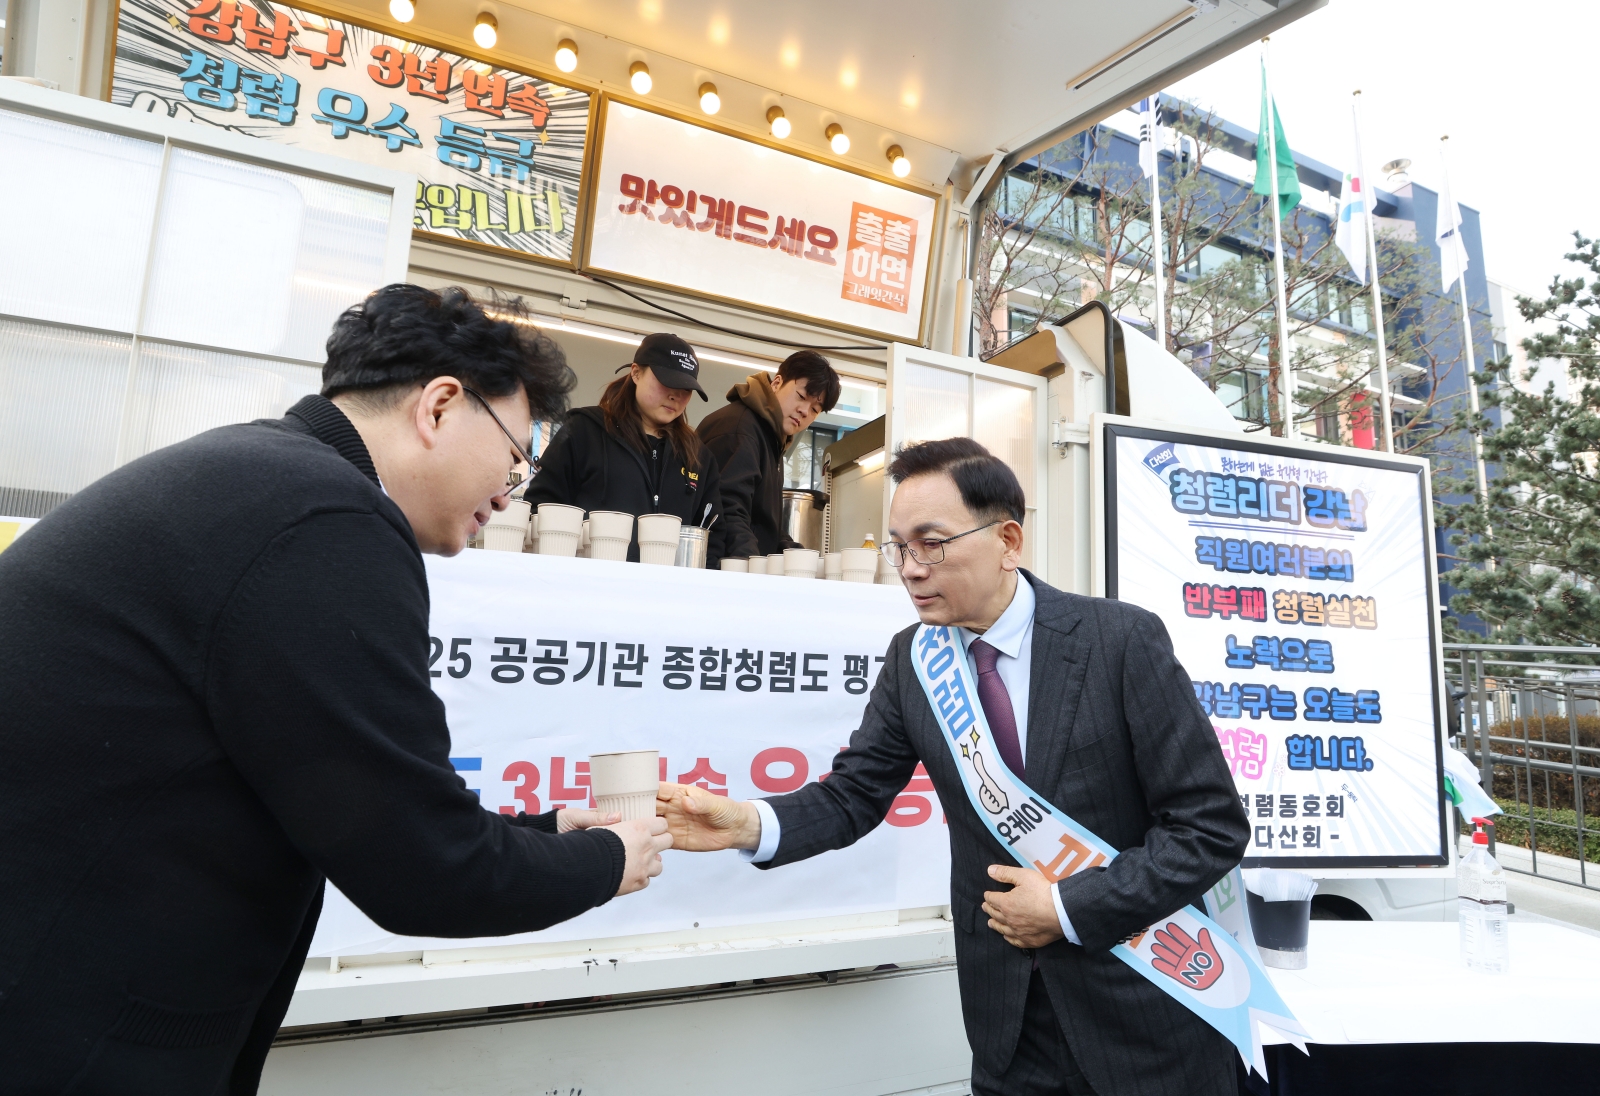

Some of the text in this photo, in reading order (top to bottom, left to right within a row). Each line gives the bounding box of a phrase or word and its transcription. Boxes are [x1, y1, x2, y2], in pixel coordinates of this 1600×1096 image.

[187, 0, 553, 128] 강남구 3년 연속
[177, 49, 537, 181] 청렴 우수 등급
[618, 173, 839, 267] 맛있게드세요
[855, 211, 911, 255] 출출
[851, 246, 908, 290] 하면
[1169, 468, 1368, 532] 청렴리더 강남
[1195, 535, 1355, 583] 직원여러분의
[1182, 581, 1378, 631] 반부패 청렴실천
[490, 637, 650, 688] 공공기관
[662, 645, 830, 693] 종합청렴도
[1225, 634, 1335, 673] 노력으로
[1303, 686, 1382, 724] 오늘도
[996, 796, 1053, 846] 오케이
[1254, 824, 1321, 849] 다산회
[1180, 951, 1213, 985] NO
